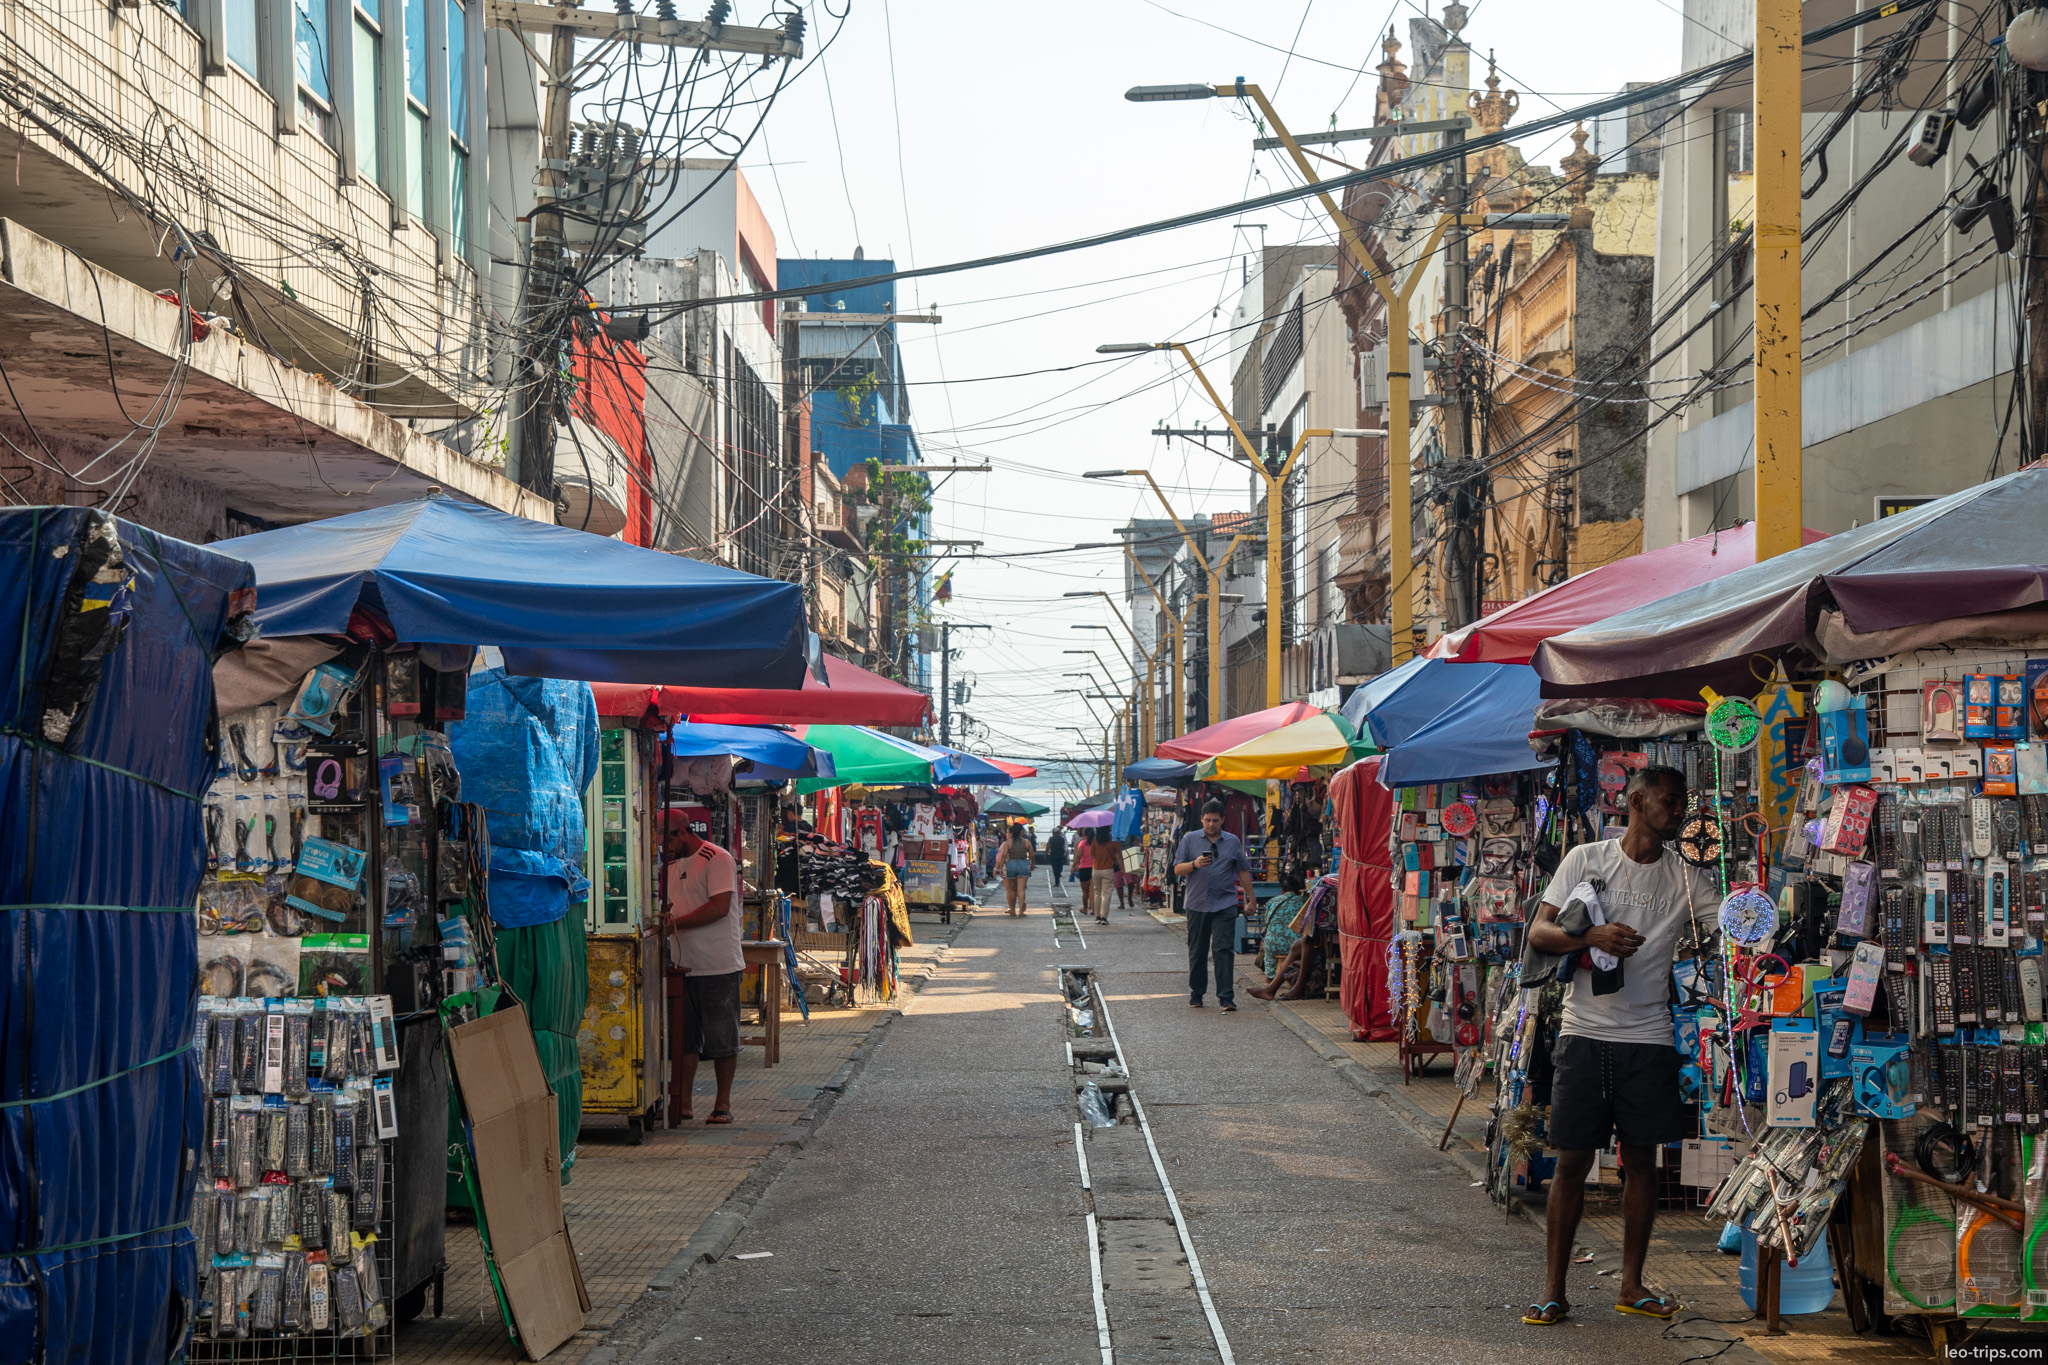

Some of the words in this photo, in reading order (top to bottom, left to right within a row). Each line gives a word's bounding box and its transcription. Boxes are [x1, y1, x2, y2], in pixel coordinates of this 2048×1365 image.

[1855, 788, 1870, 798] CAT
[689, 821, 707, 832] cia
[305, 846, 329, 859] inova
